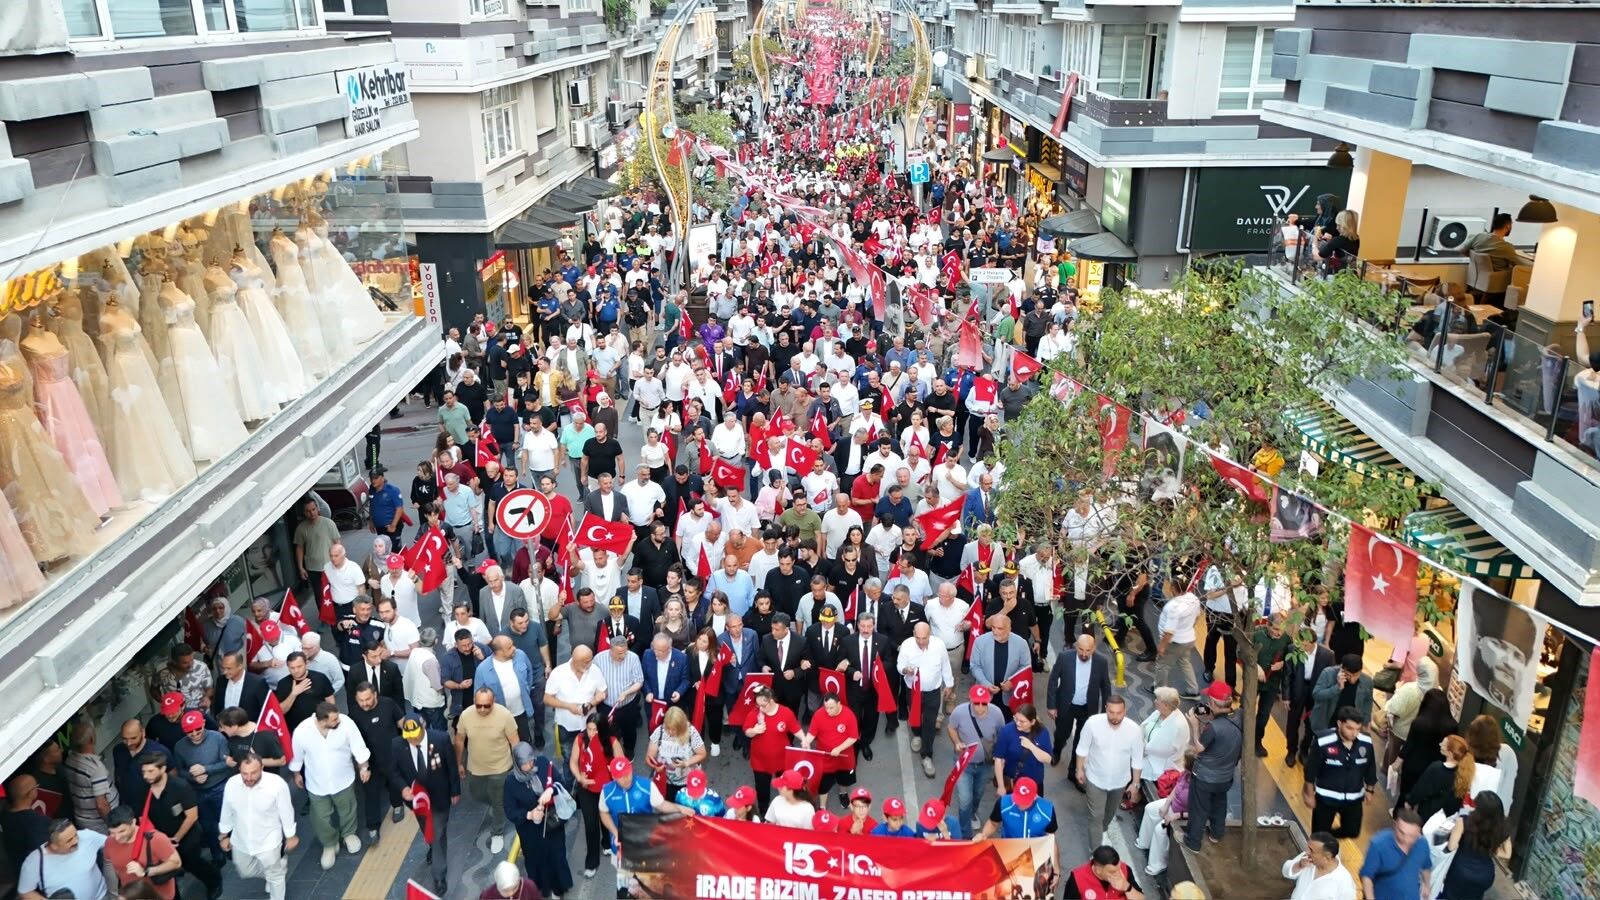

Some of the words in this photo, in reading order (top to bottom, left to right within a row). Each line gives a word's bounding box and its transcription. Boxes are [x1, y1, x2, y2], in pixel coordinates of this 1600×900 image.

[358, 68, 406, 100] Kehribar
[366, 119, 381, 133] SALON
[1236, 217, 1273, 225] DAVID
[760, 877, 824, 900] BİZİM
